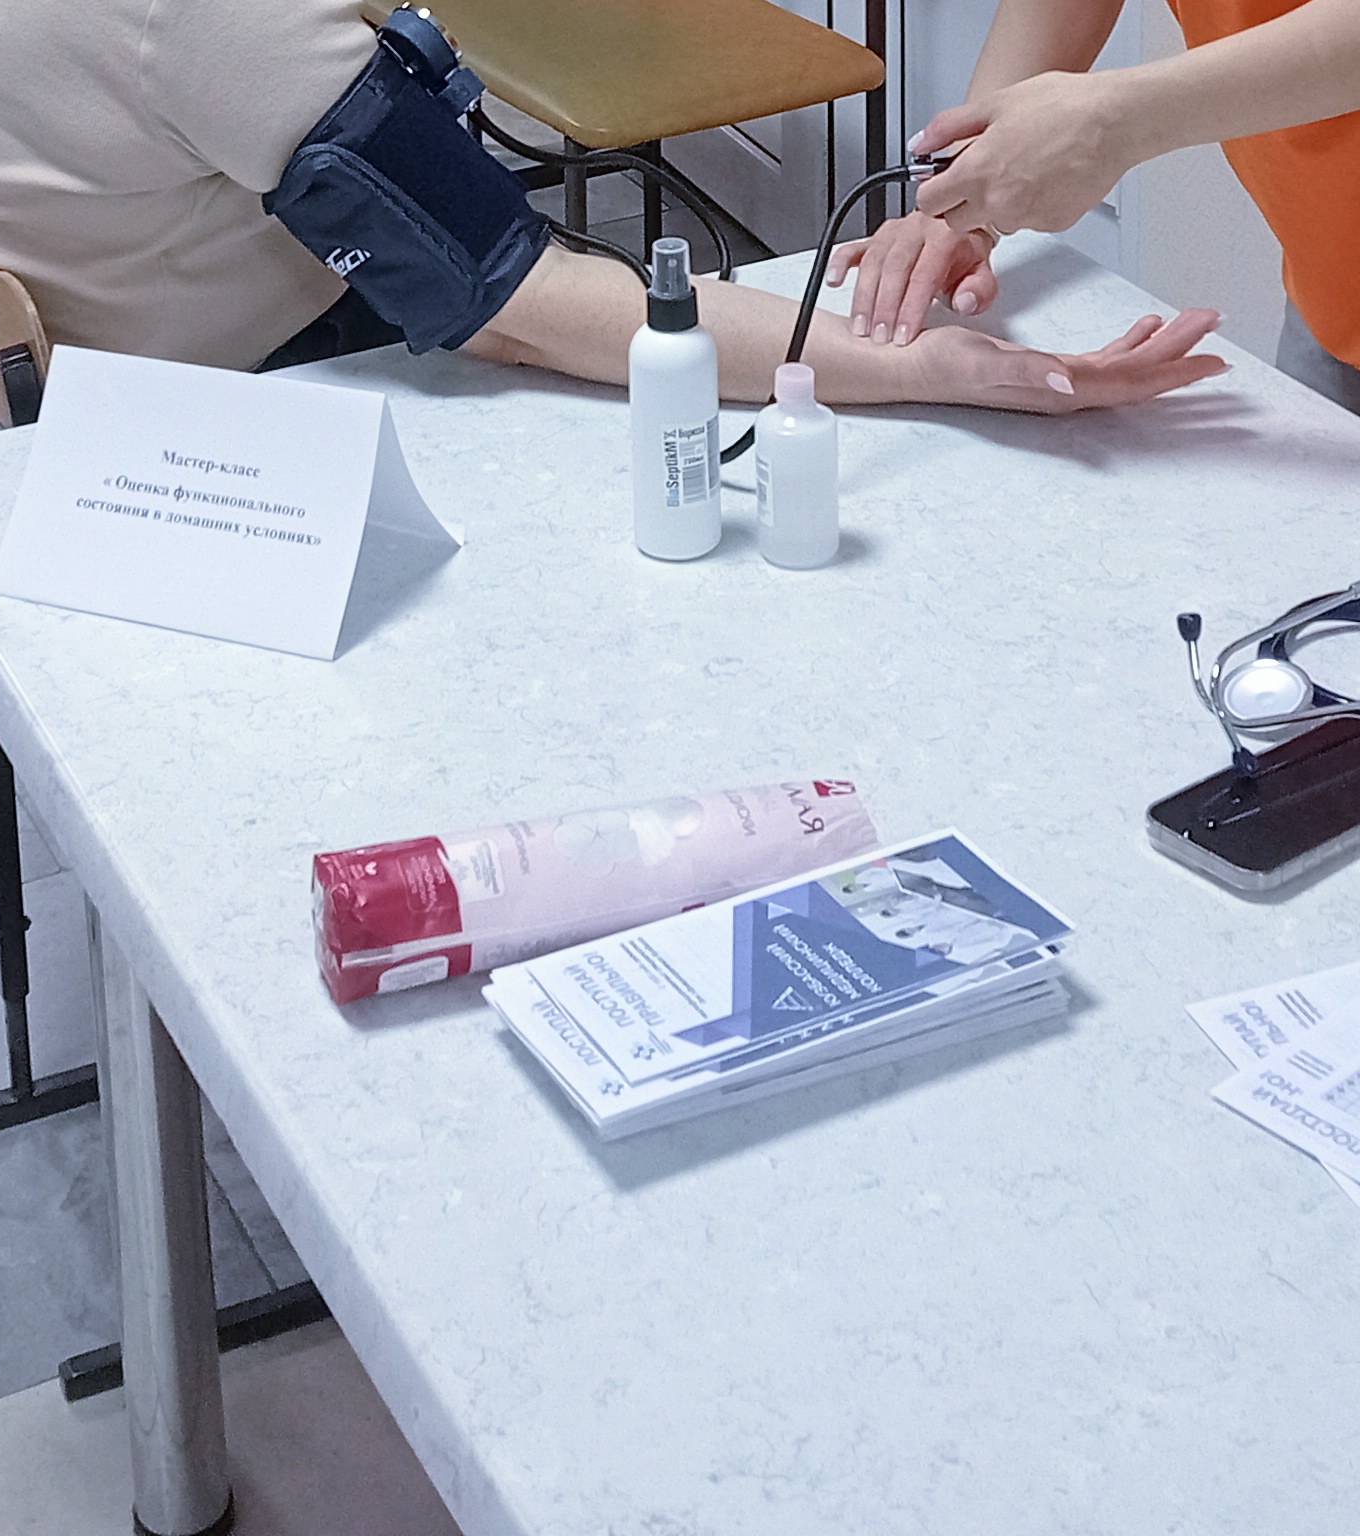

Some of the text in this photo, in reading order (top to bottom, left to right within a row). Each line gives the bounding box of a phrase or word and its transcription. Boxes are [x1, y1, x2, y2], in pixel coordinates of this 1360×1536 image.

[161, 449, 261, 479] Мастер-класс
[76, 496, 150, 521] состояния
[164, 510, 241, 535] домашних
[244, 521, 322, 548] условиях»
[114, 474, 170, 498] Оценка
[173, 484, 307, 520] функционального
[562, 959, 635, 1030] ПОСТУПАЙ
[581, 946, 666, 1029] ПРАВИЛЬНО!
[529, 996, 603, 1069] ПОСТУПАЙ
